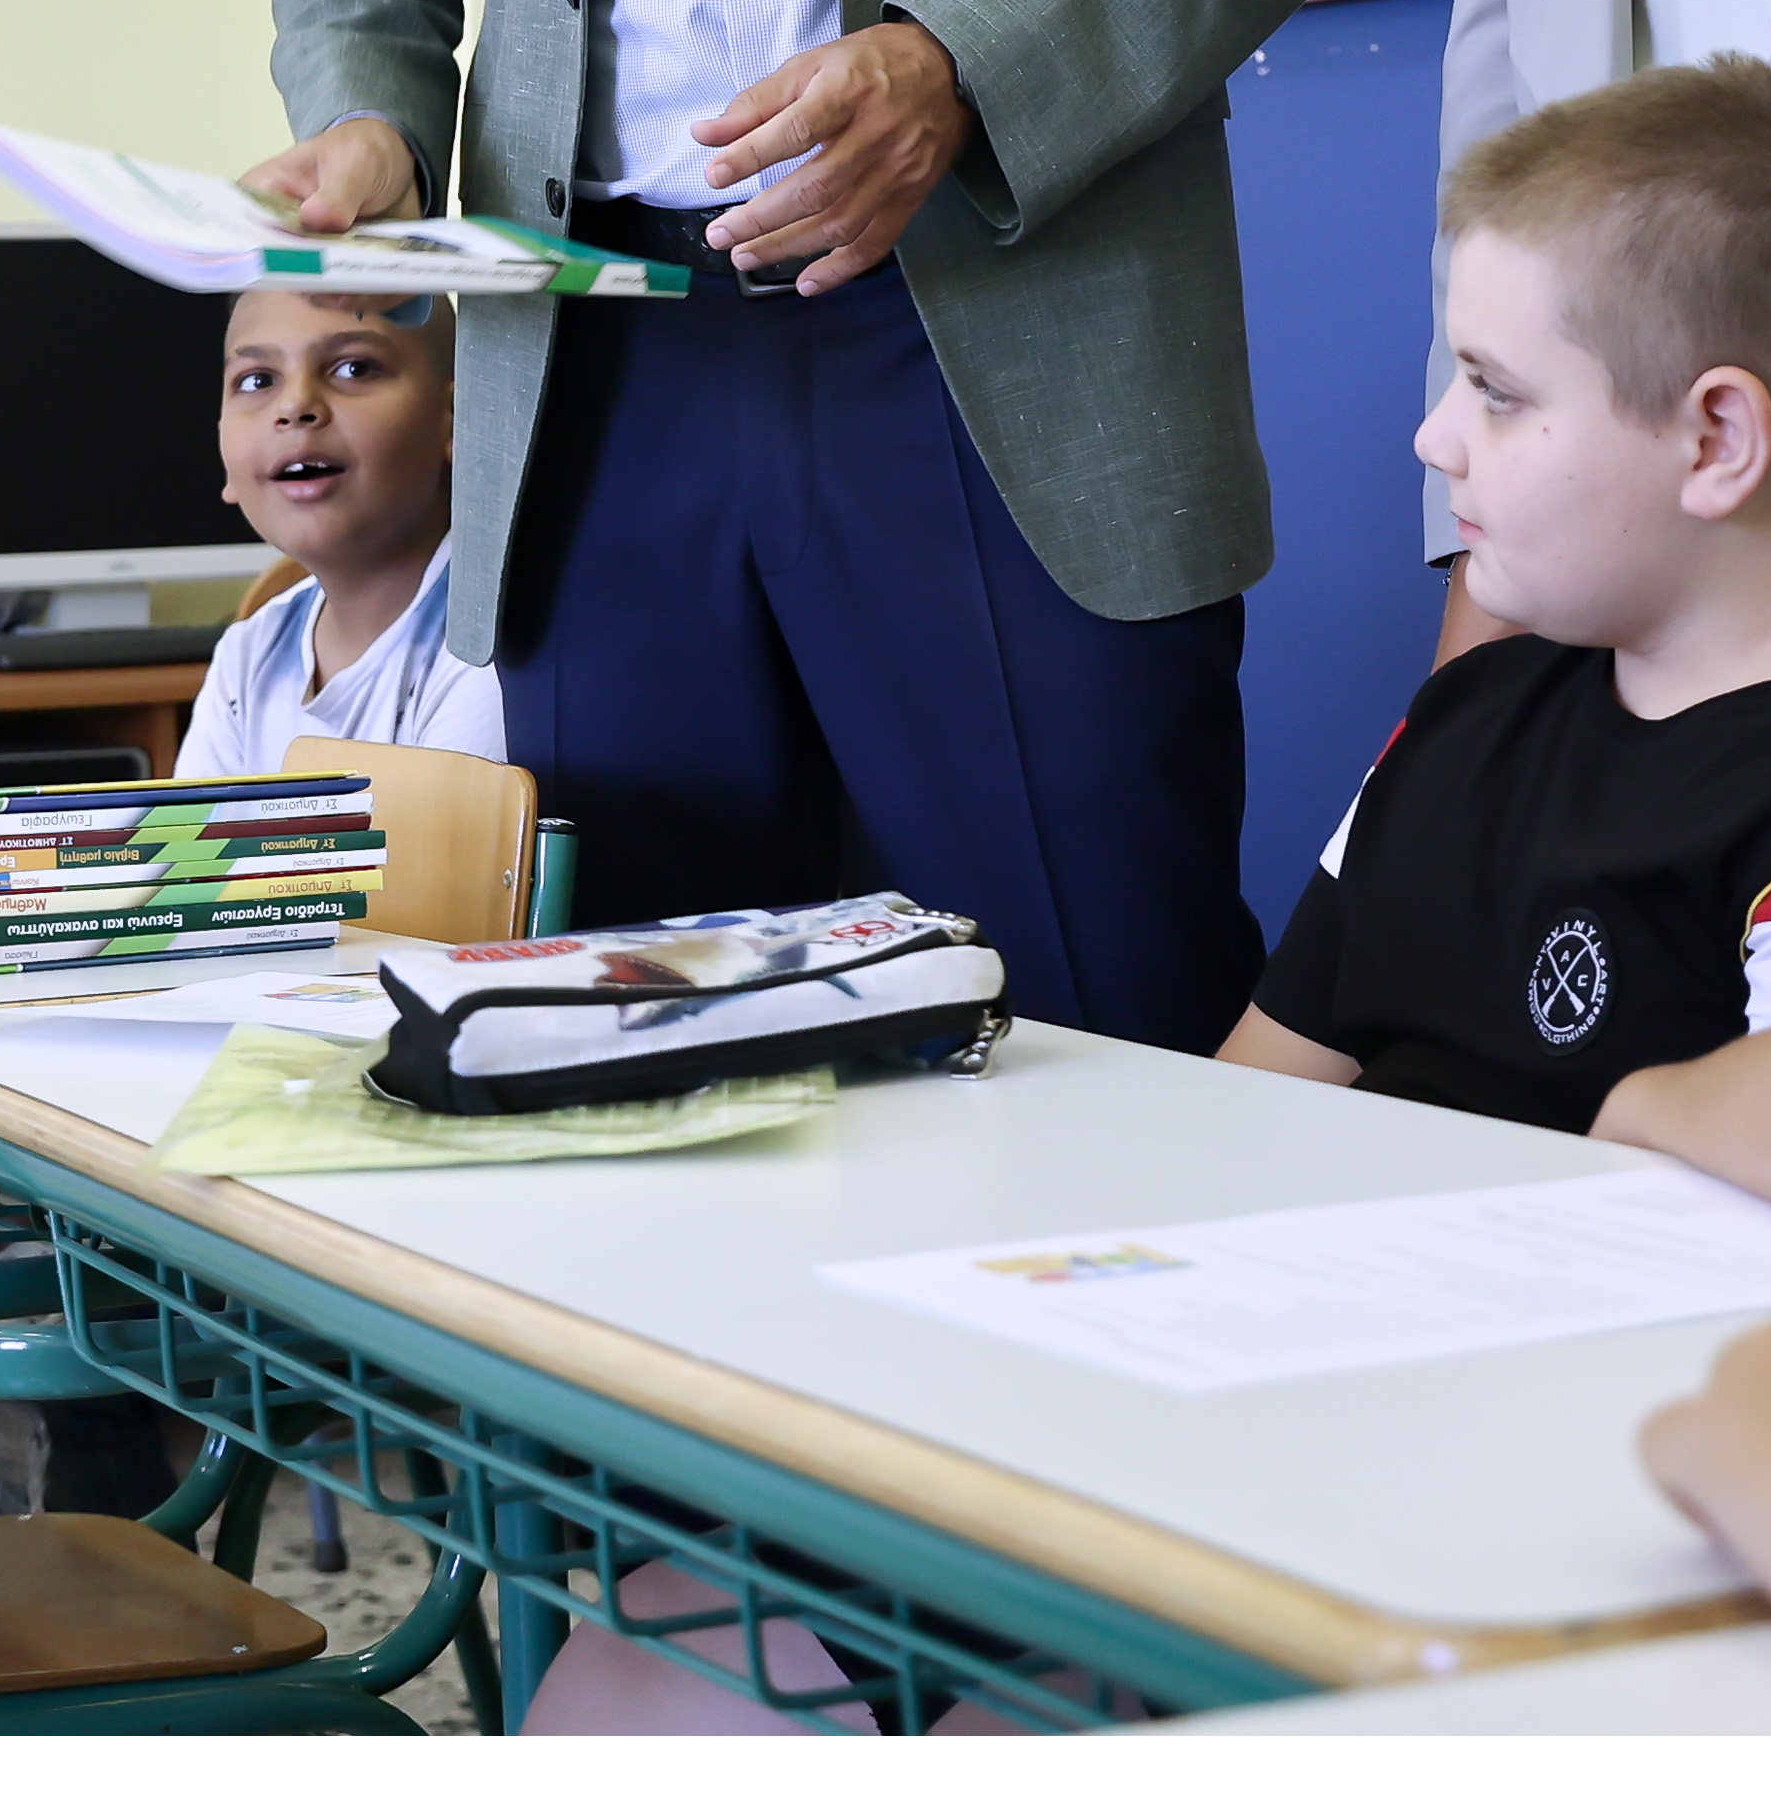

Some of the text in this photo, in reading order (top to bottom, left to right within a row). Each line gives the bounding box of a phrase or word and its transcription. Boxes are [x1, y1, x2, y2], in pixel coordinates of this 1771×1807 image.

[261, 799, 318, 814] Δημοτικού
[21, 813, 92, 830] Γεωγραφία
[0, 837, 57, 849] ΔΗΜΟΤΙΚΟΥ
[261, 839, 318, 853] Δημοτικού
[60, 849, 139, 865] Βιβλίο μαθητή
[268, 881, 332, 895] Δημοτικού
[211, 902, 345, 923] Τετράδιο Εργασιών
[7, 914, 183, 940] Ερευνώ και ανακαλύπτω
[1550, 919, 1602, 956] VINYL
[1560, 950, 1570, 963] A
[1542, 977, 1551, 991] V
[1577, 974, 1588, 987] C
[1595, 969, 1608, 1006] ART
